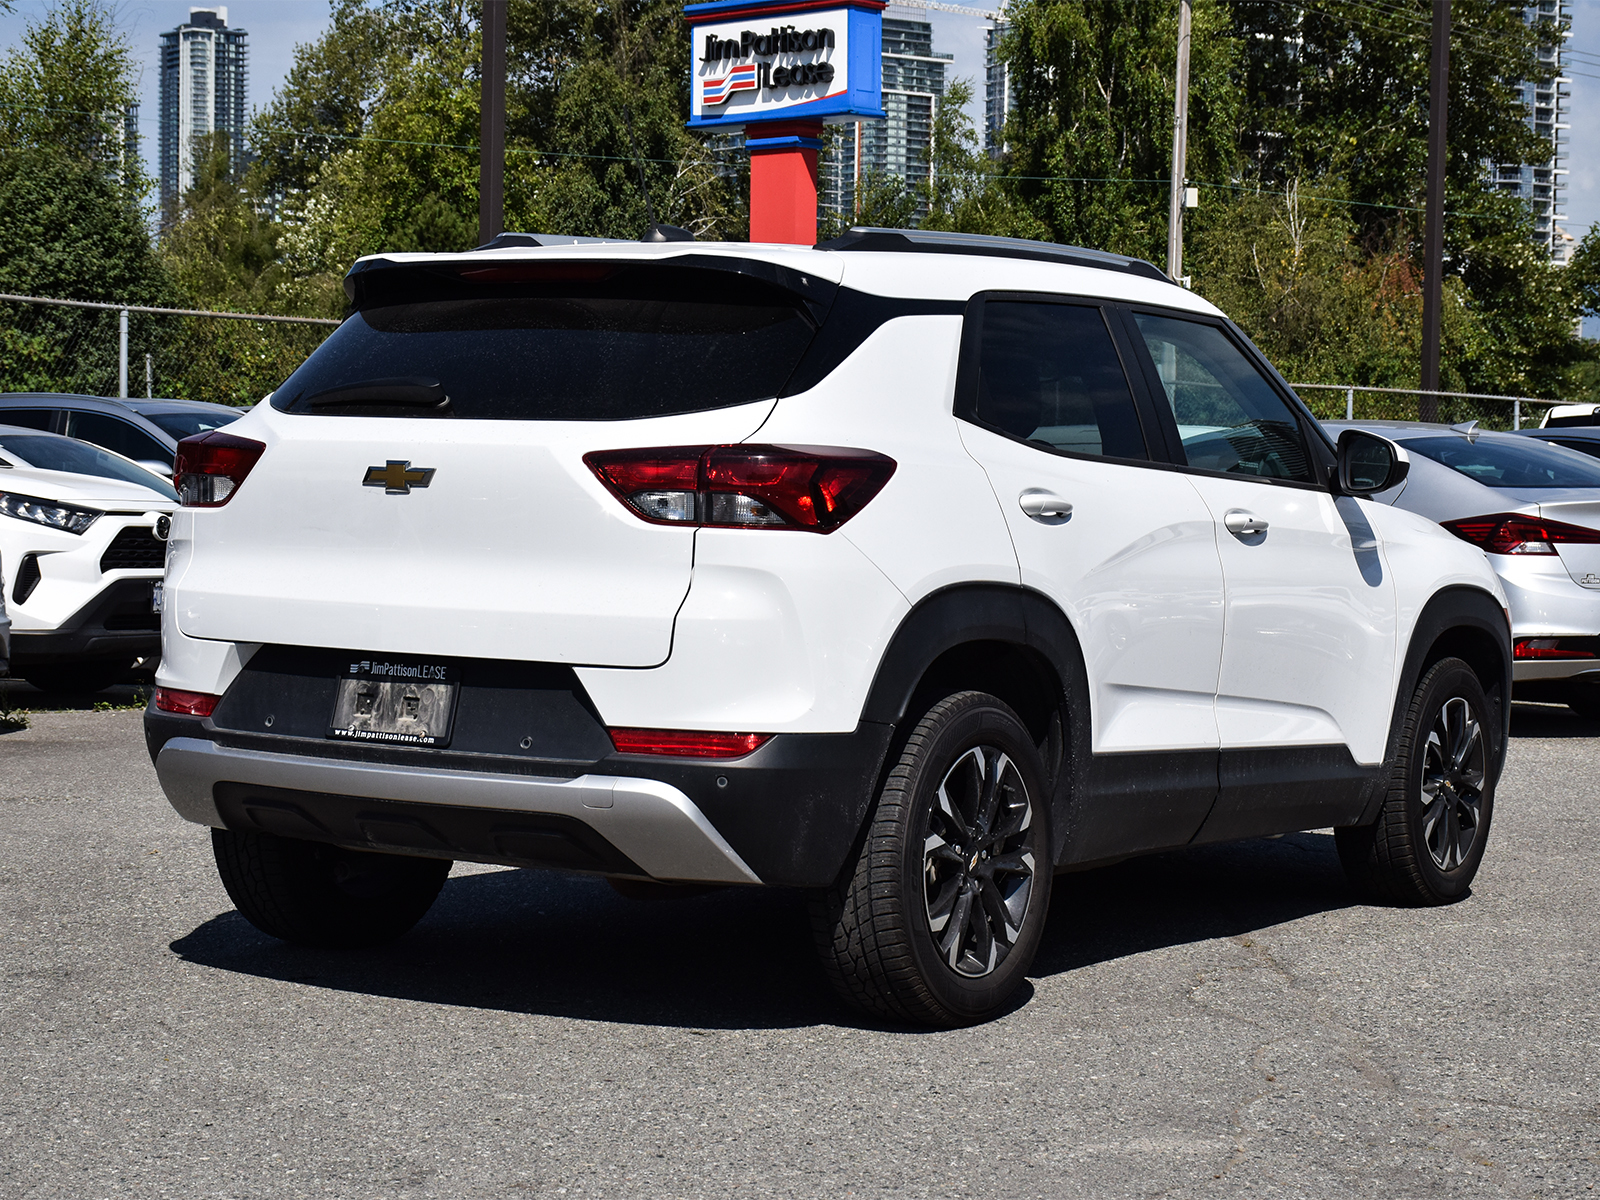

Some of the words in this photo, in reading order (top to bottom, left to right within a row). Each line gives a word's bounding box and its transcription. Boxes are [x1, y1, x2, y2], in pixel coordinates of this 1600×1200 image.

[699, 34, 740, 62] Jim
[741, 25, 836, 58] Pattison
[762, 61, 835, 89] Lease
[370, 662, 447, 680] JimPattisonLEASE
[334, 729, 435, 744] www.jimpattisonlease.com
